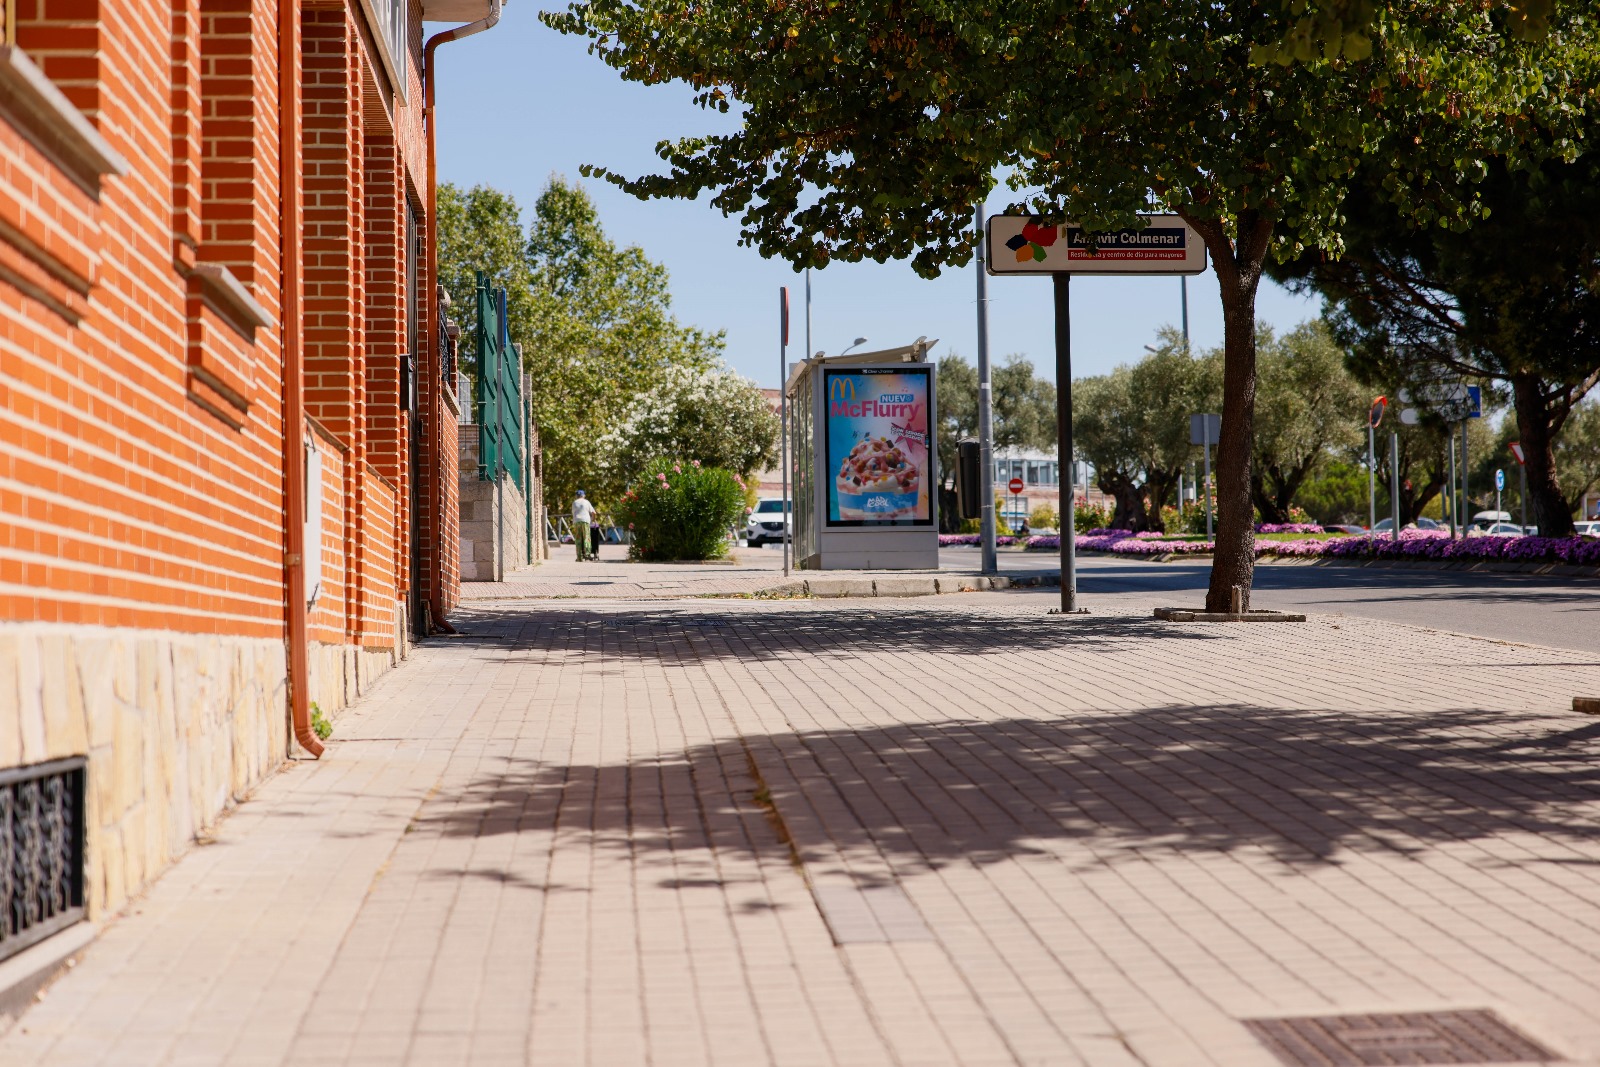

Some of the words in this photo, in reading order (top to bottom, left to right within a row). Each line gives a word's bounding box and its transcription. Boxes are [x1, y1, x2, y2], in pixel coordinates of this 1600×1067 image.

[1073, 232, 1118, 244] Avir
[1120, 232, 1180, 244] Colmenar
[881, 395, 913, 403] NUEVO
[830, 400, 919, 421] McFlurry
